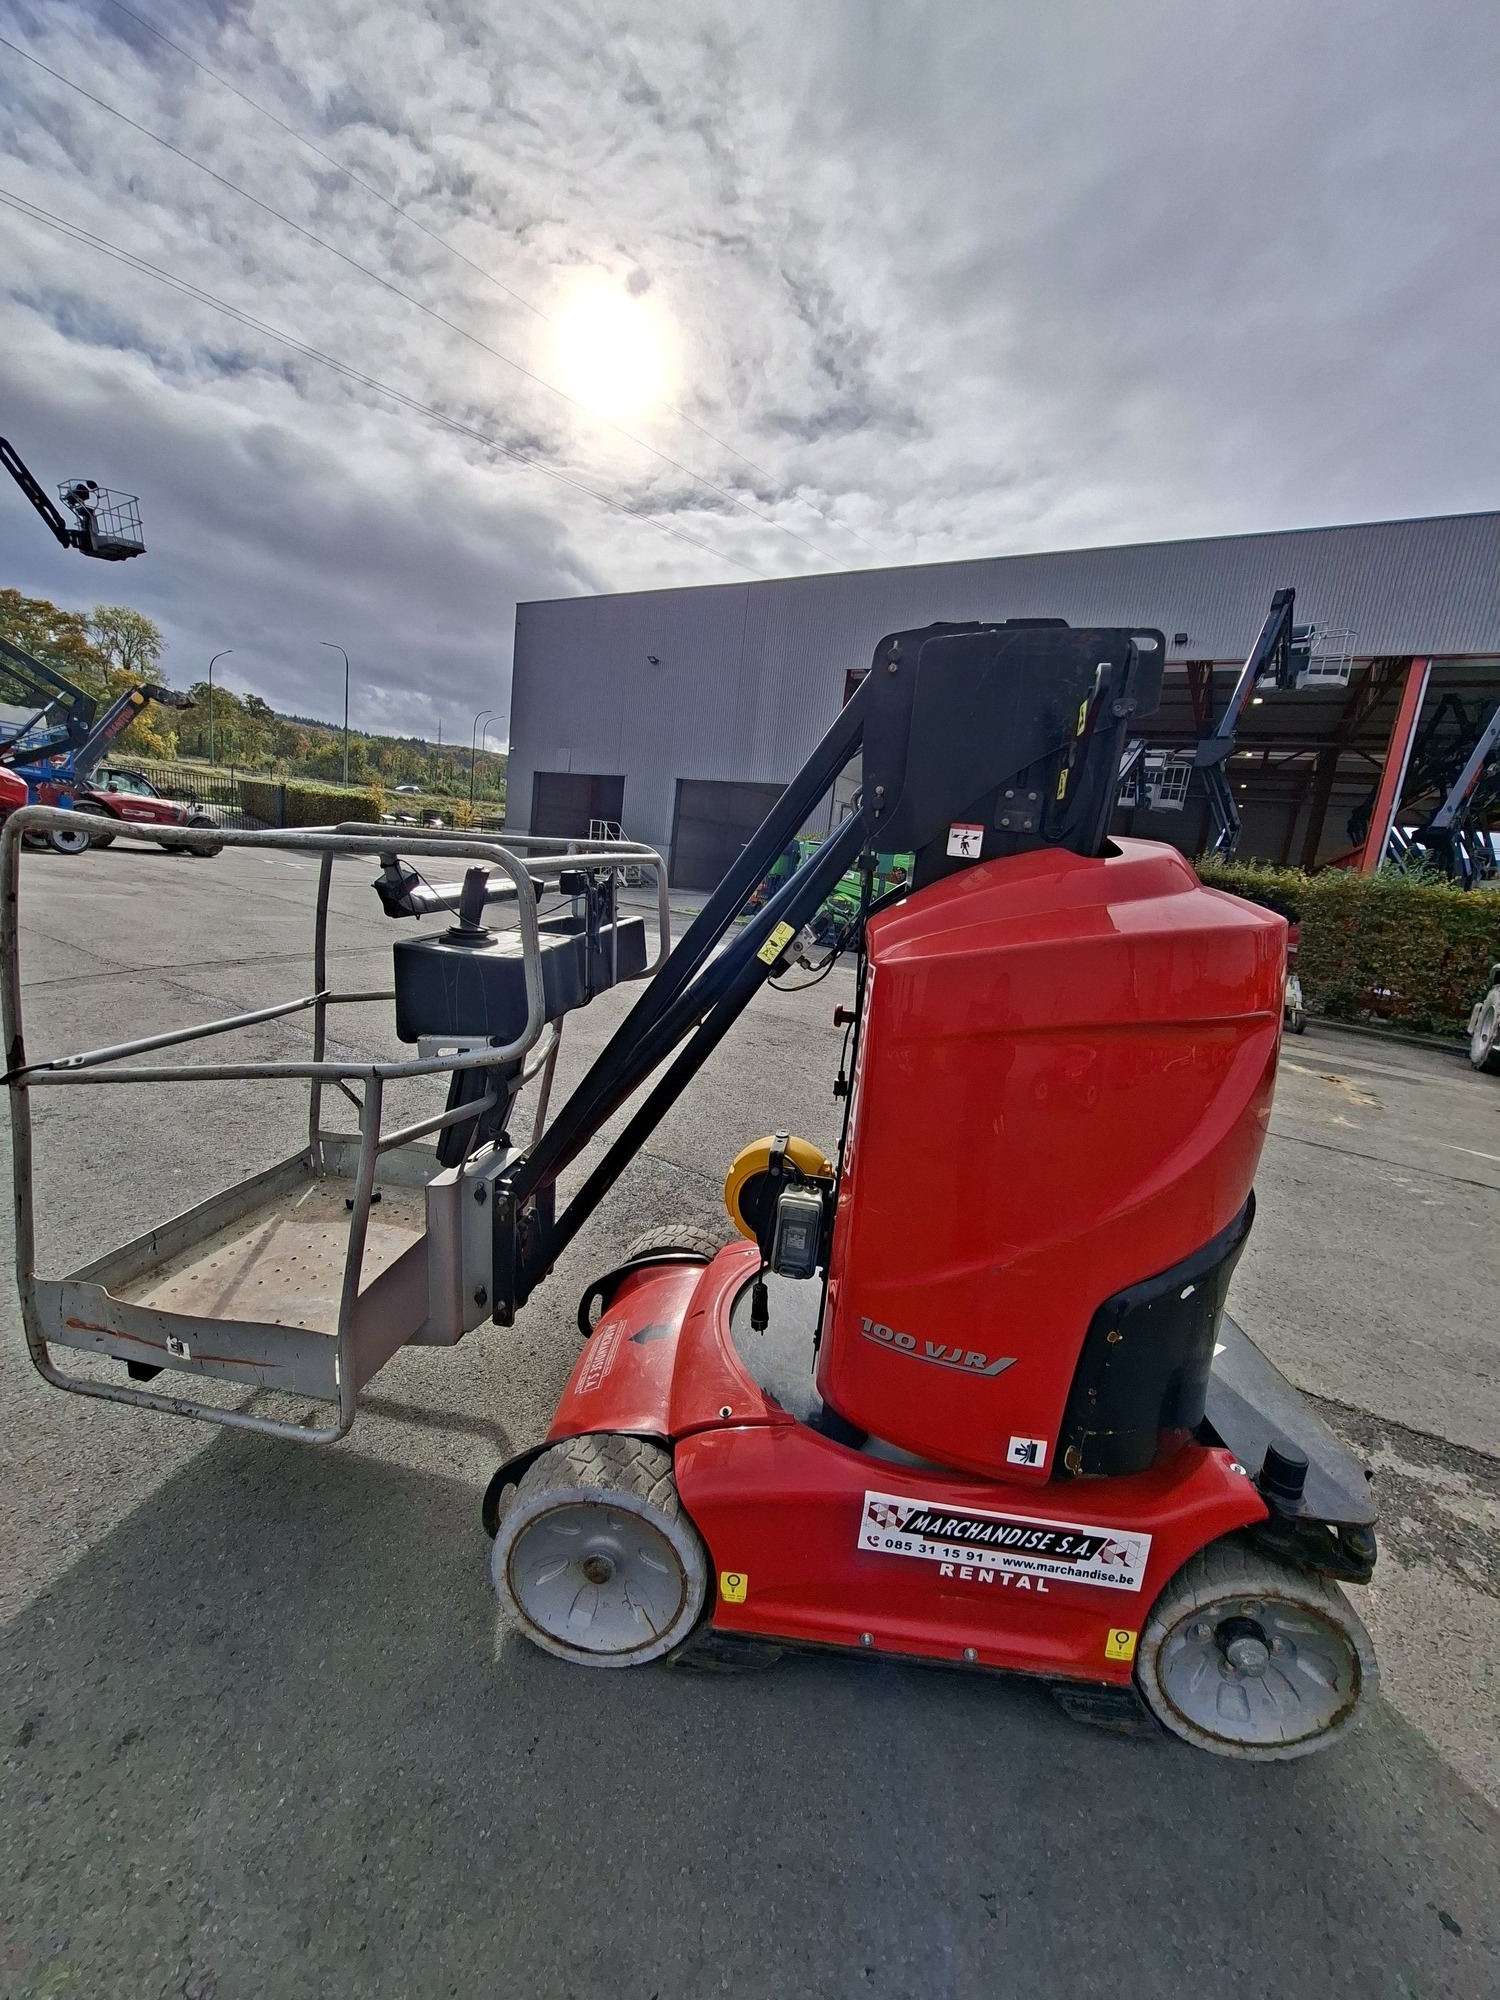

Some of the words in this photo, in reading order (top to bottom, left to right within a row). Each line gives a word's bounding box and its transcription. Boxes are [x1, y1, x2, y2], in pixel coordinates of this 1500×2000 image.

[861, 1316, 917, 1350] 100
[925, 1340, 988, 1369] VJR
[909, 1514, 1056, 1550] MARCHANDISE
[1055, 1536, 1091, 1557] S.A.
[884, 1538, 913, 1551] 085
[918, 1543, 936, 1555] 31
[942, 1547, 961, 1559] 15
[966, 1551, 984, 1562] 91
[1002, 1557, 1135, 1585] www.marchandise.be
[939, 1563, 1050, 1593] RENTAL
